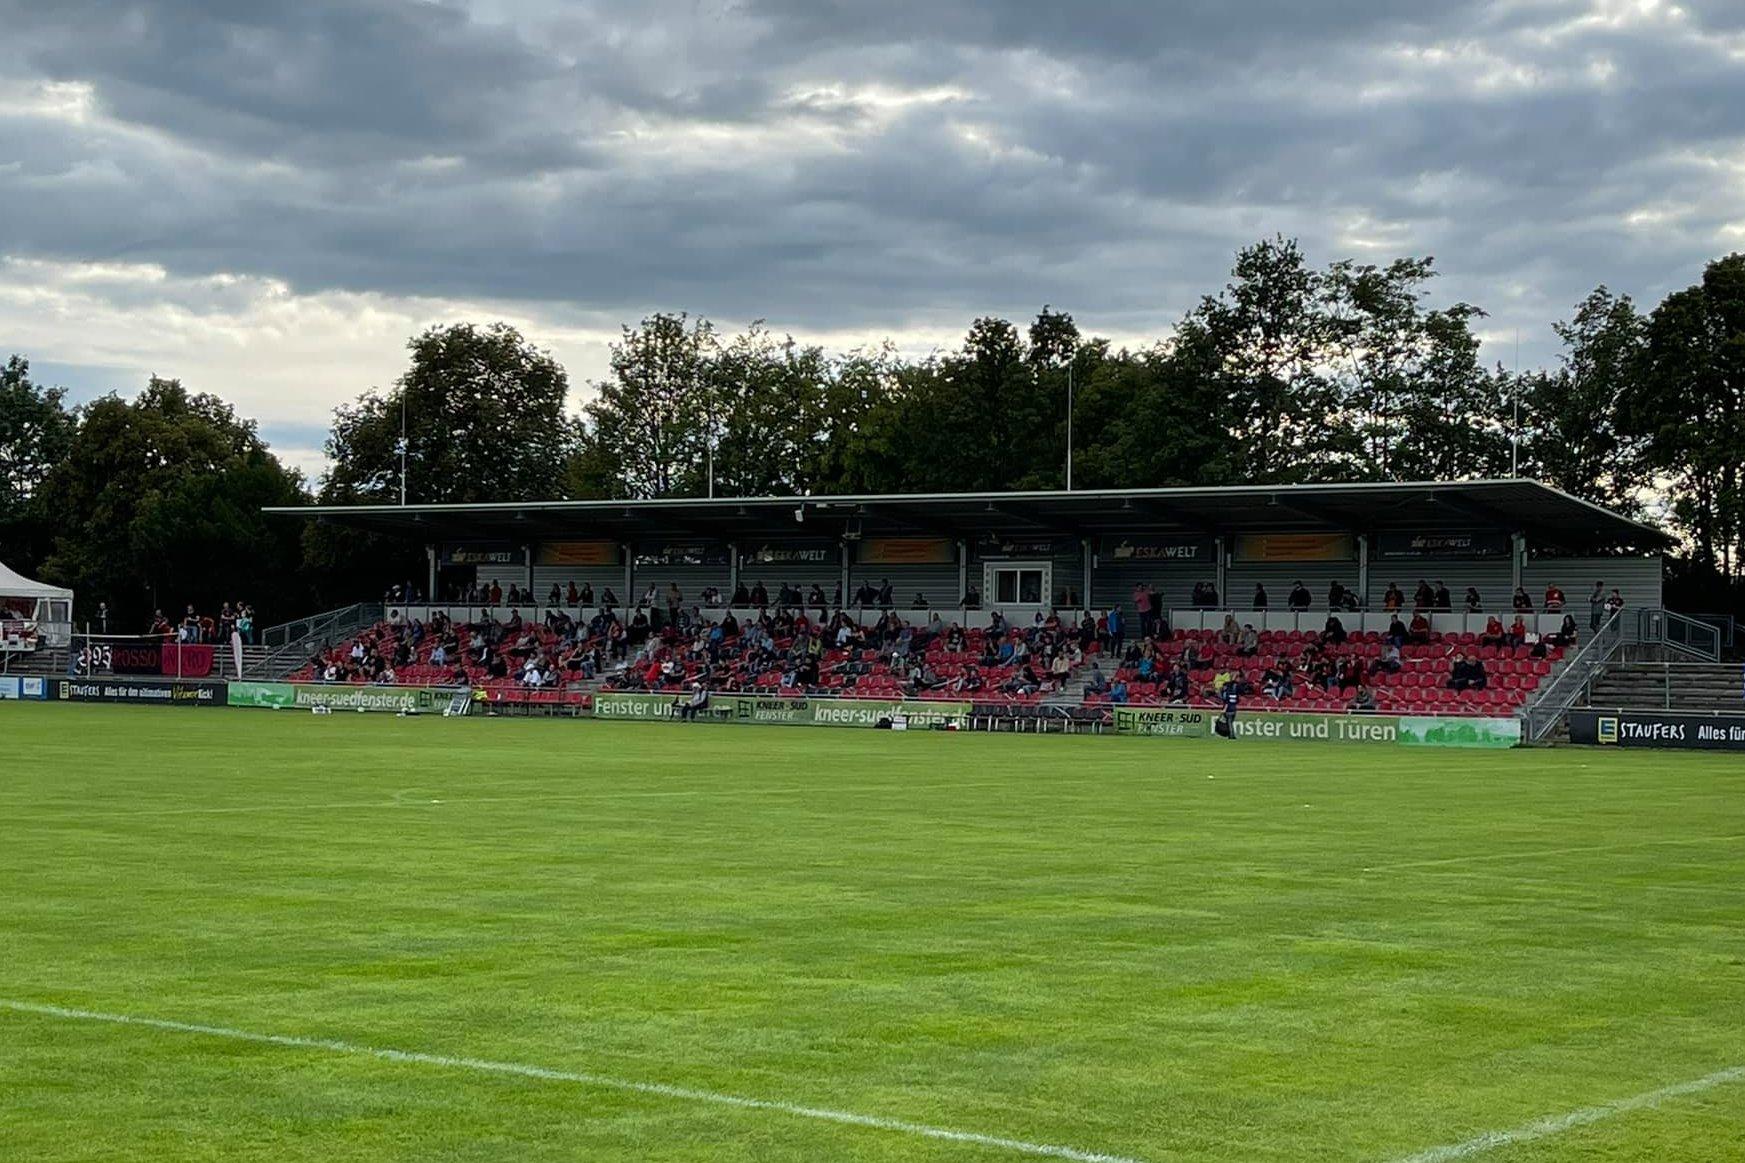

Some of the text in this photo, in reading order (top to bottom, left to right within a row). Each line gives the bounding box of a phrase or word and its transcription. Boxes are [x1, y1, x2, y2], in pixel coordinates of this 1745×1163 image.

[595, 697, 649, 716] Fenster
[1289, 718, 1329, 738] und
[1335, 719, 1396, 741] Türen
[1620, 722, 1686, 741] STAUFERS
[1697, 725, 1727, 740] Alles
